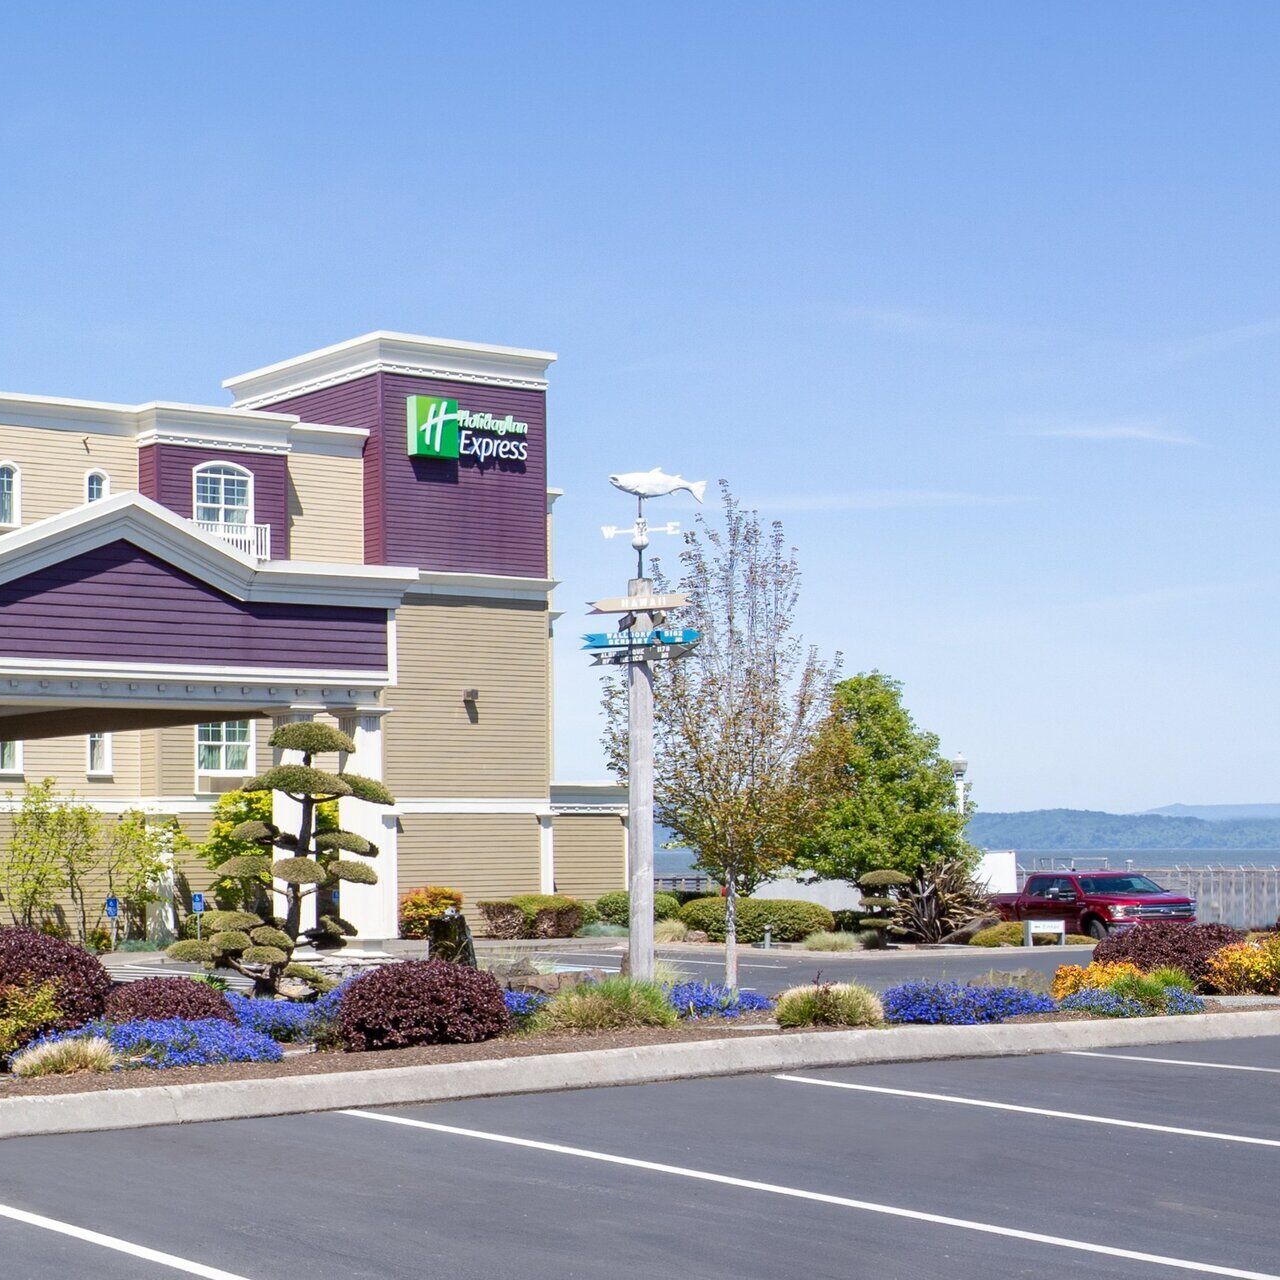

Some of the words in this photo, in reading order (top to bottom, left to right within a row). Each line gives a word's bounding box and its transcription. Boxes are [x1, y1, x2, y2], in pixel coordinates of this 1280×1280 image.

[456, 409, 507, 435] Holiday
[507, 415, 528, 434] Inn
[459, 430, 528, 462] Express
[621, 596, 667, 608] HAWAII
